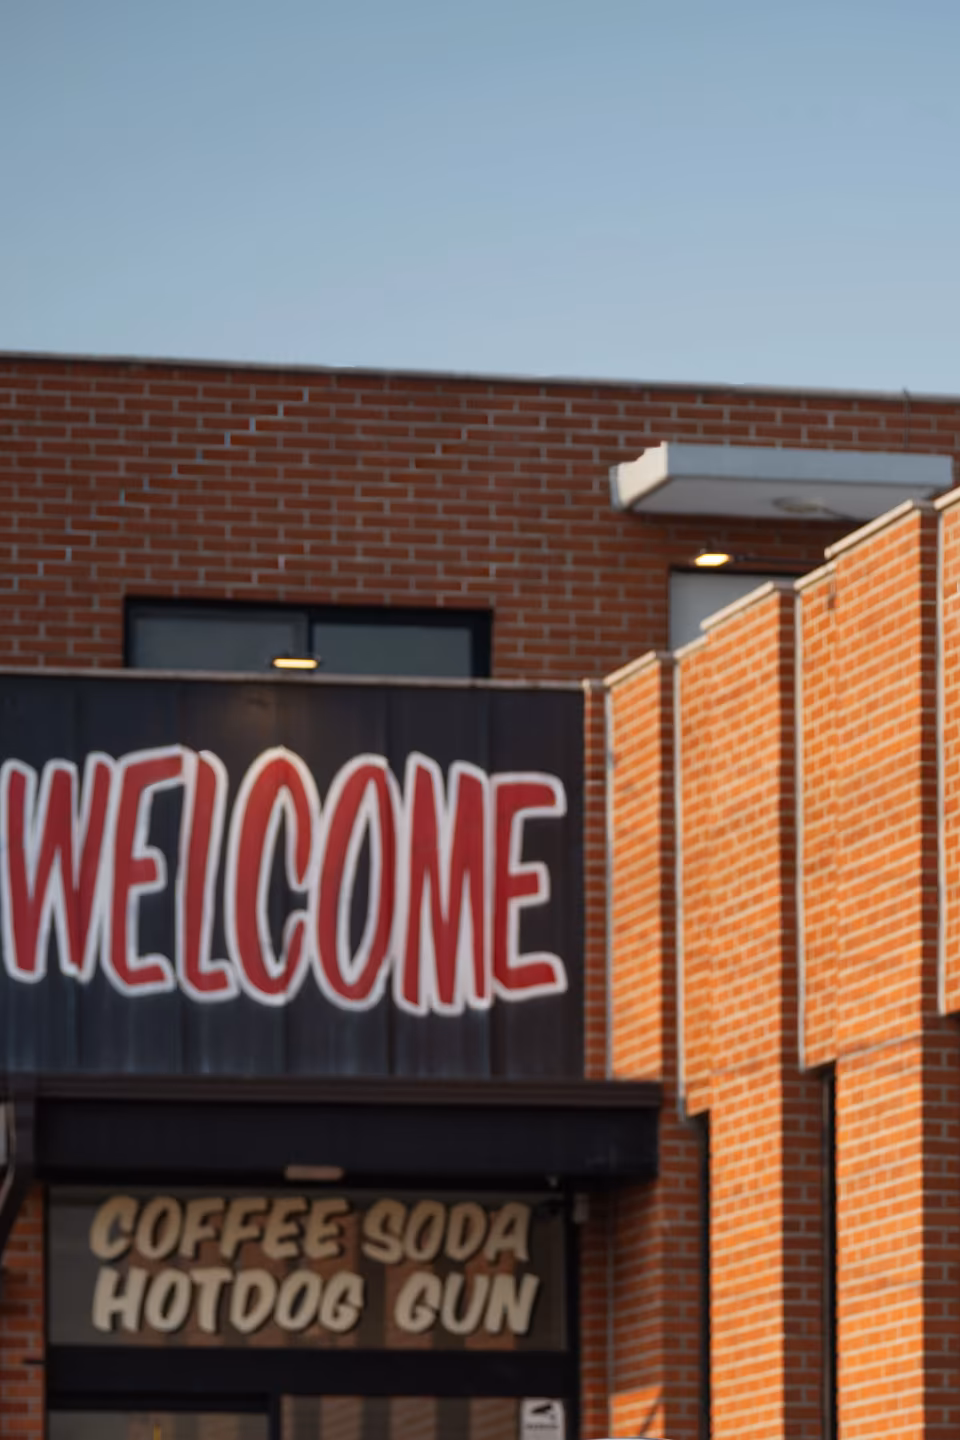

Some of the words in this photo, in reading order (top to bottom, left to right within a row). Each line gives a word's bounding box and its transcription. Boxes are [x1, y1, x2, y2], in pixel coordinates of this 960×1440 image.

[0, 745, 566, 1016] WELCOME
[90, 1196, 351, 1261] COFFEE
[363, 1199, 532, 1264] SODA
[92, 1268, 365, 1335] HOTDOG
[395, 1273, 539, 1336] GUN
